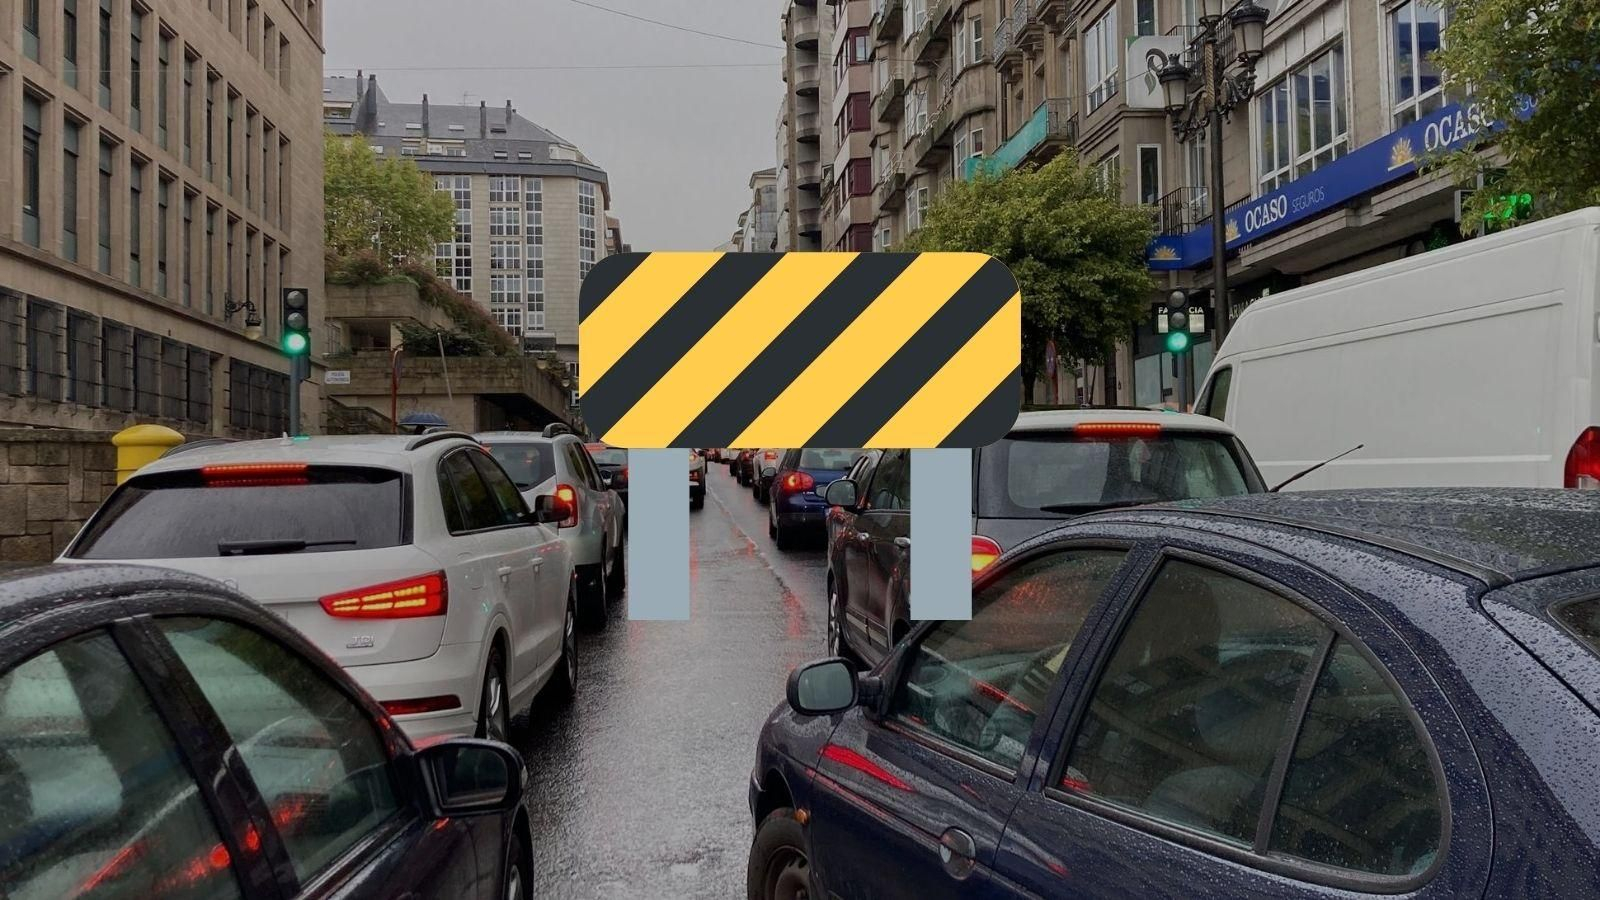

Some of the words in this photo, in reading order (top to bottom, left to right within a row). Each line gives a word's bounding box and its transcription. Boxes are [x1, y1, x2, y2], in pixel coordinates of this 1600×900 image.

[1245, 194, 1287, 233] OCASO
[1292, 186, 1325, 213] SEGUROS
[1158, 306, 1204, 314] FACIA
